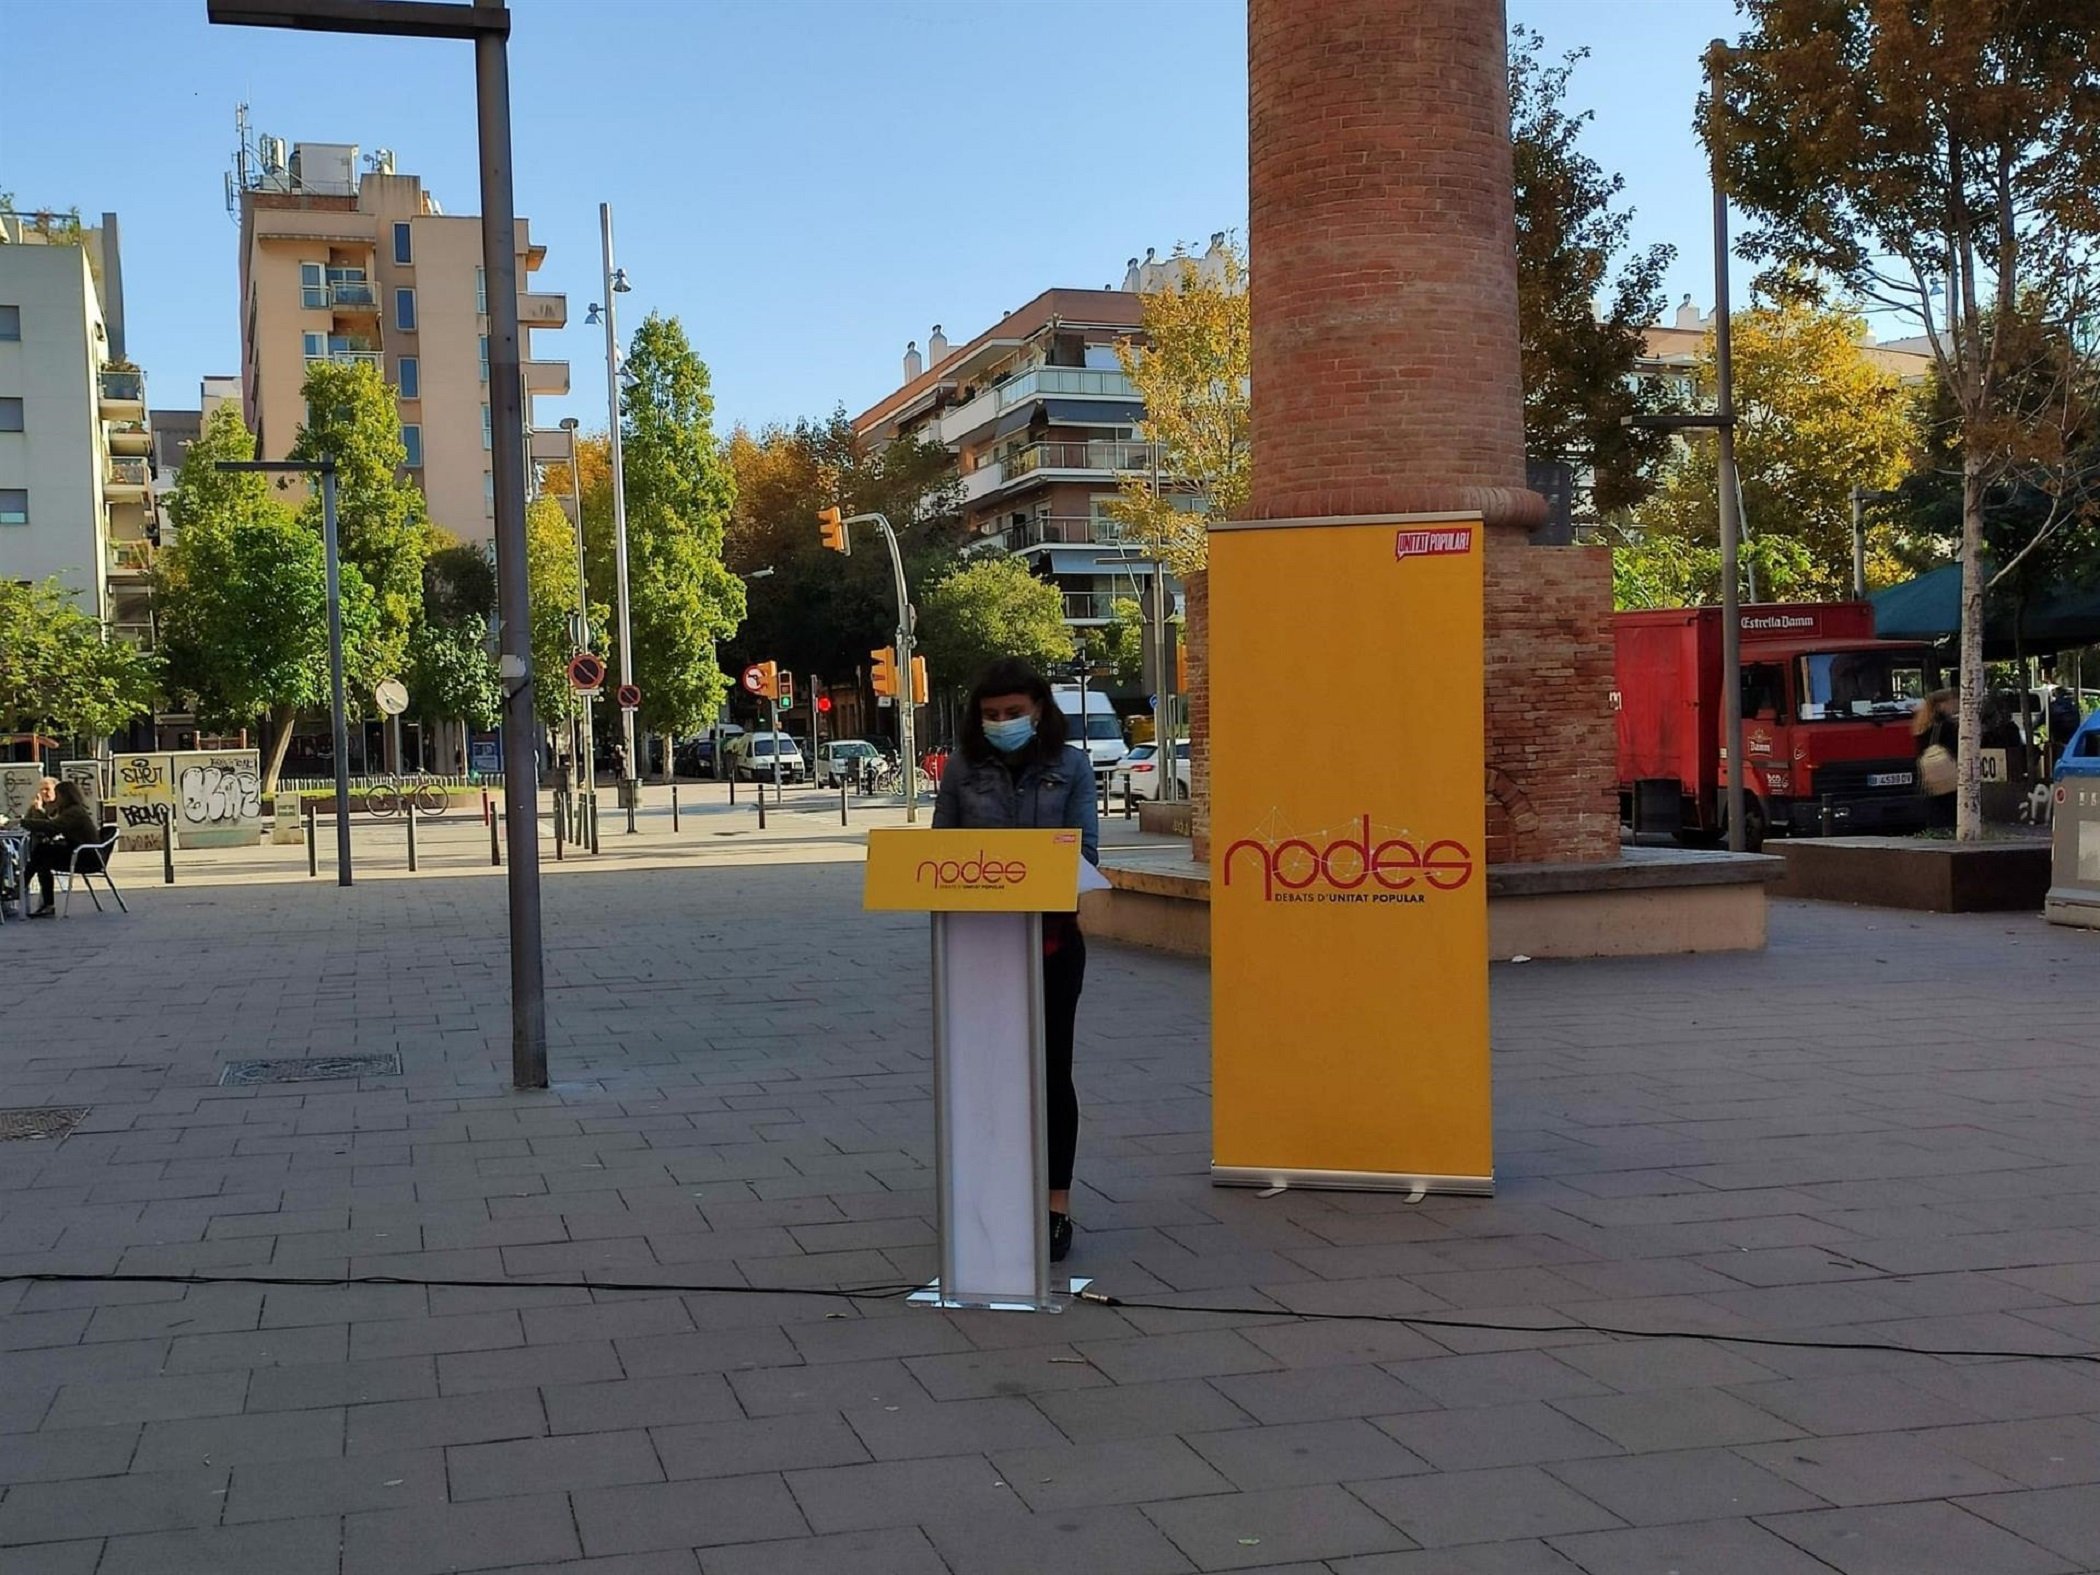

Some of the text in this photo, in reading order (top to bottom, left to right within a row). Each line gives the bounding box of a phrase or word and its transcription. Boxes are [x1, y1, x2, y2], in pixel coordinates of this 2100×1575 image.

[1399, 532, 1470, 553] UNITAT POPULAR!
[1740, 615, 1813, 629] Estrella Damm
[1224, 814, 1472, 901] nodes
[916, 849, 1027, 890] nodes
[1275, 892, 1425, 904] DEBATS D'UNITAT POPULAR
